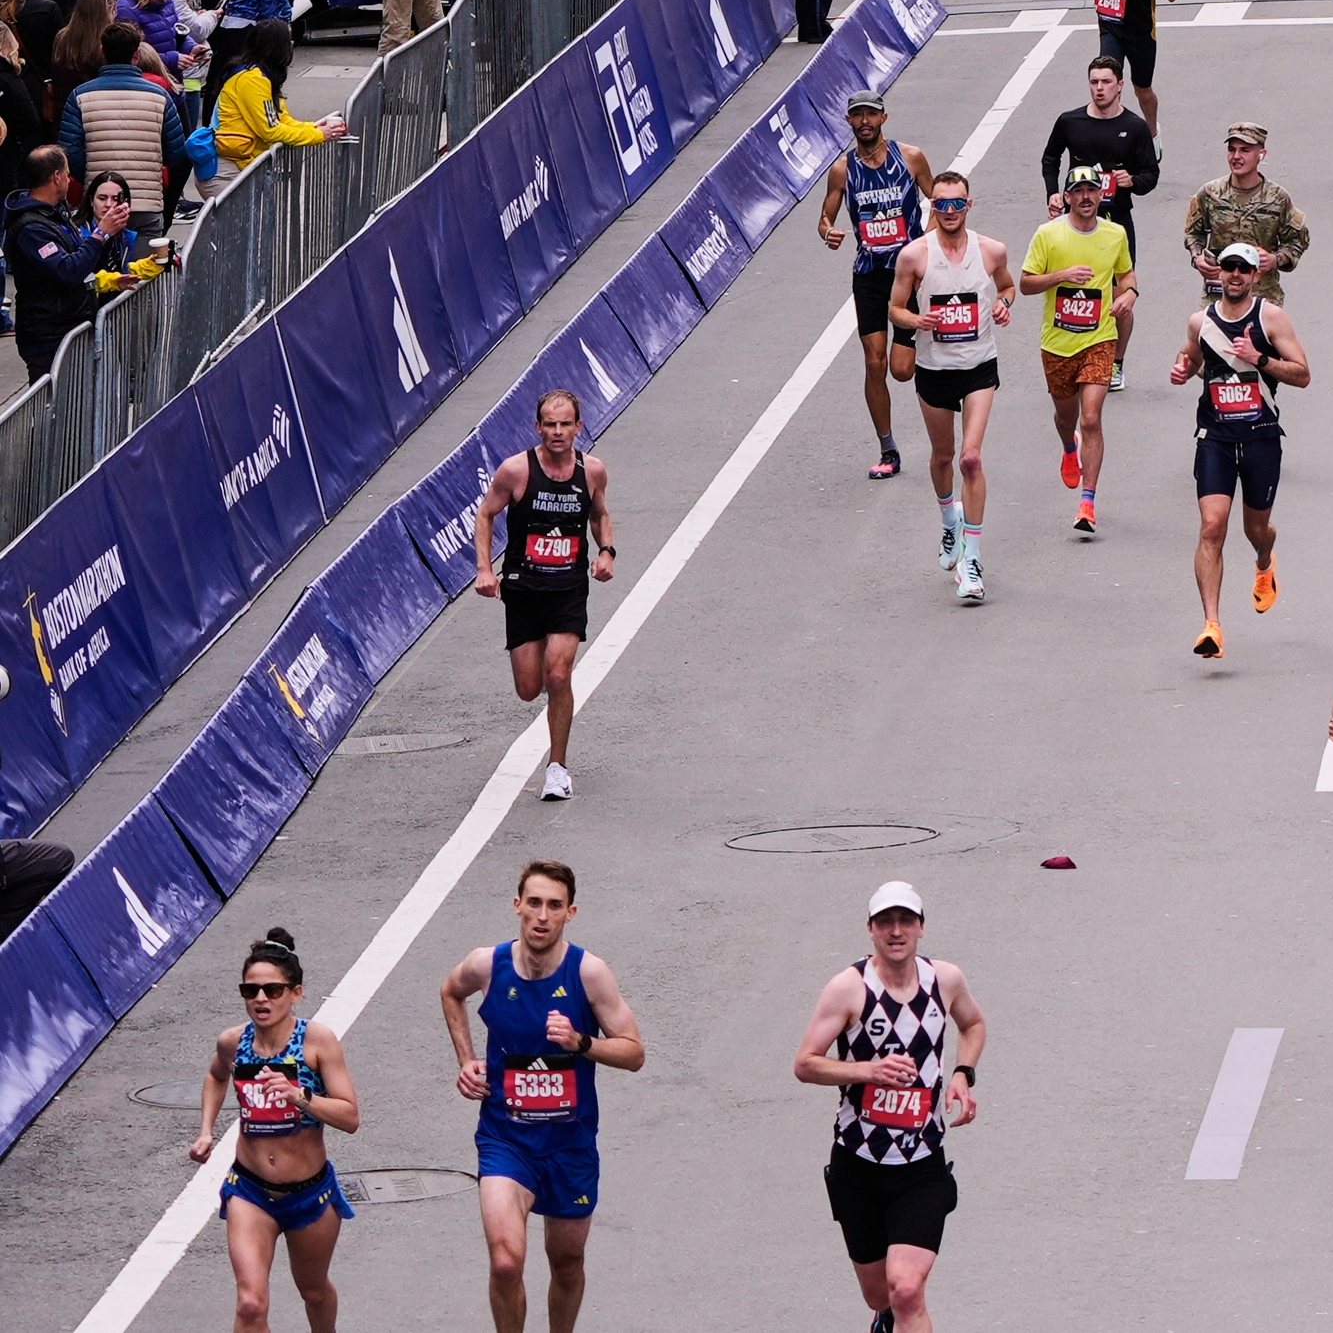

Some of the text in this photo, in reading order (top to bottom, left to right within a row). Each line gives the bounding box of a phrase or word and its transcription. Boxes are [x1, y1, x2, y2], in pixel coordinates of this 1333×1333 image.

[866, 223, 898, 238] 6026
[1062, 301, 1095, 317] 3422
[1218, 385, 1253, 404] 5062
[537, 491, 578, 502] NEW YORK
[532, 500, 581, 513] HARRIERS
[534, 538, 571, 557] 4790
[514, 1073, 564, 1097] 5333
[872, 1086, 922, 1116] 2074
